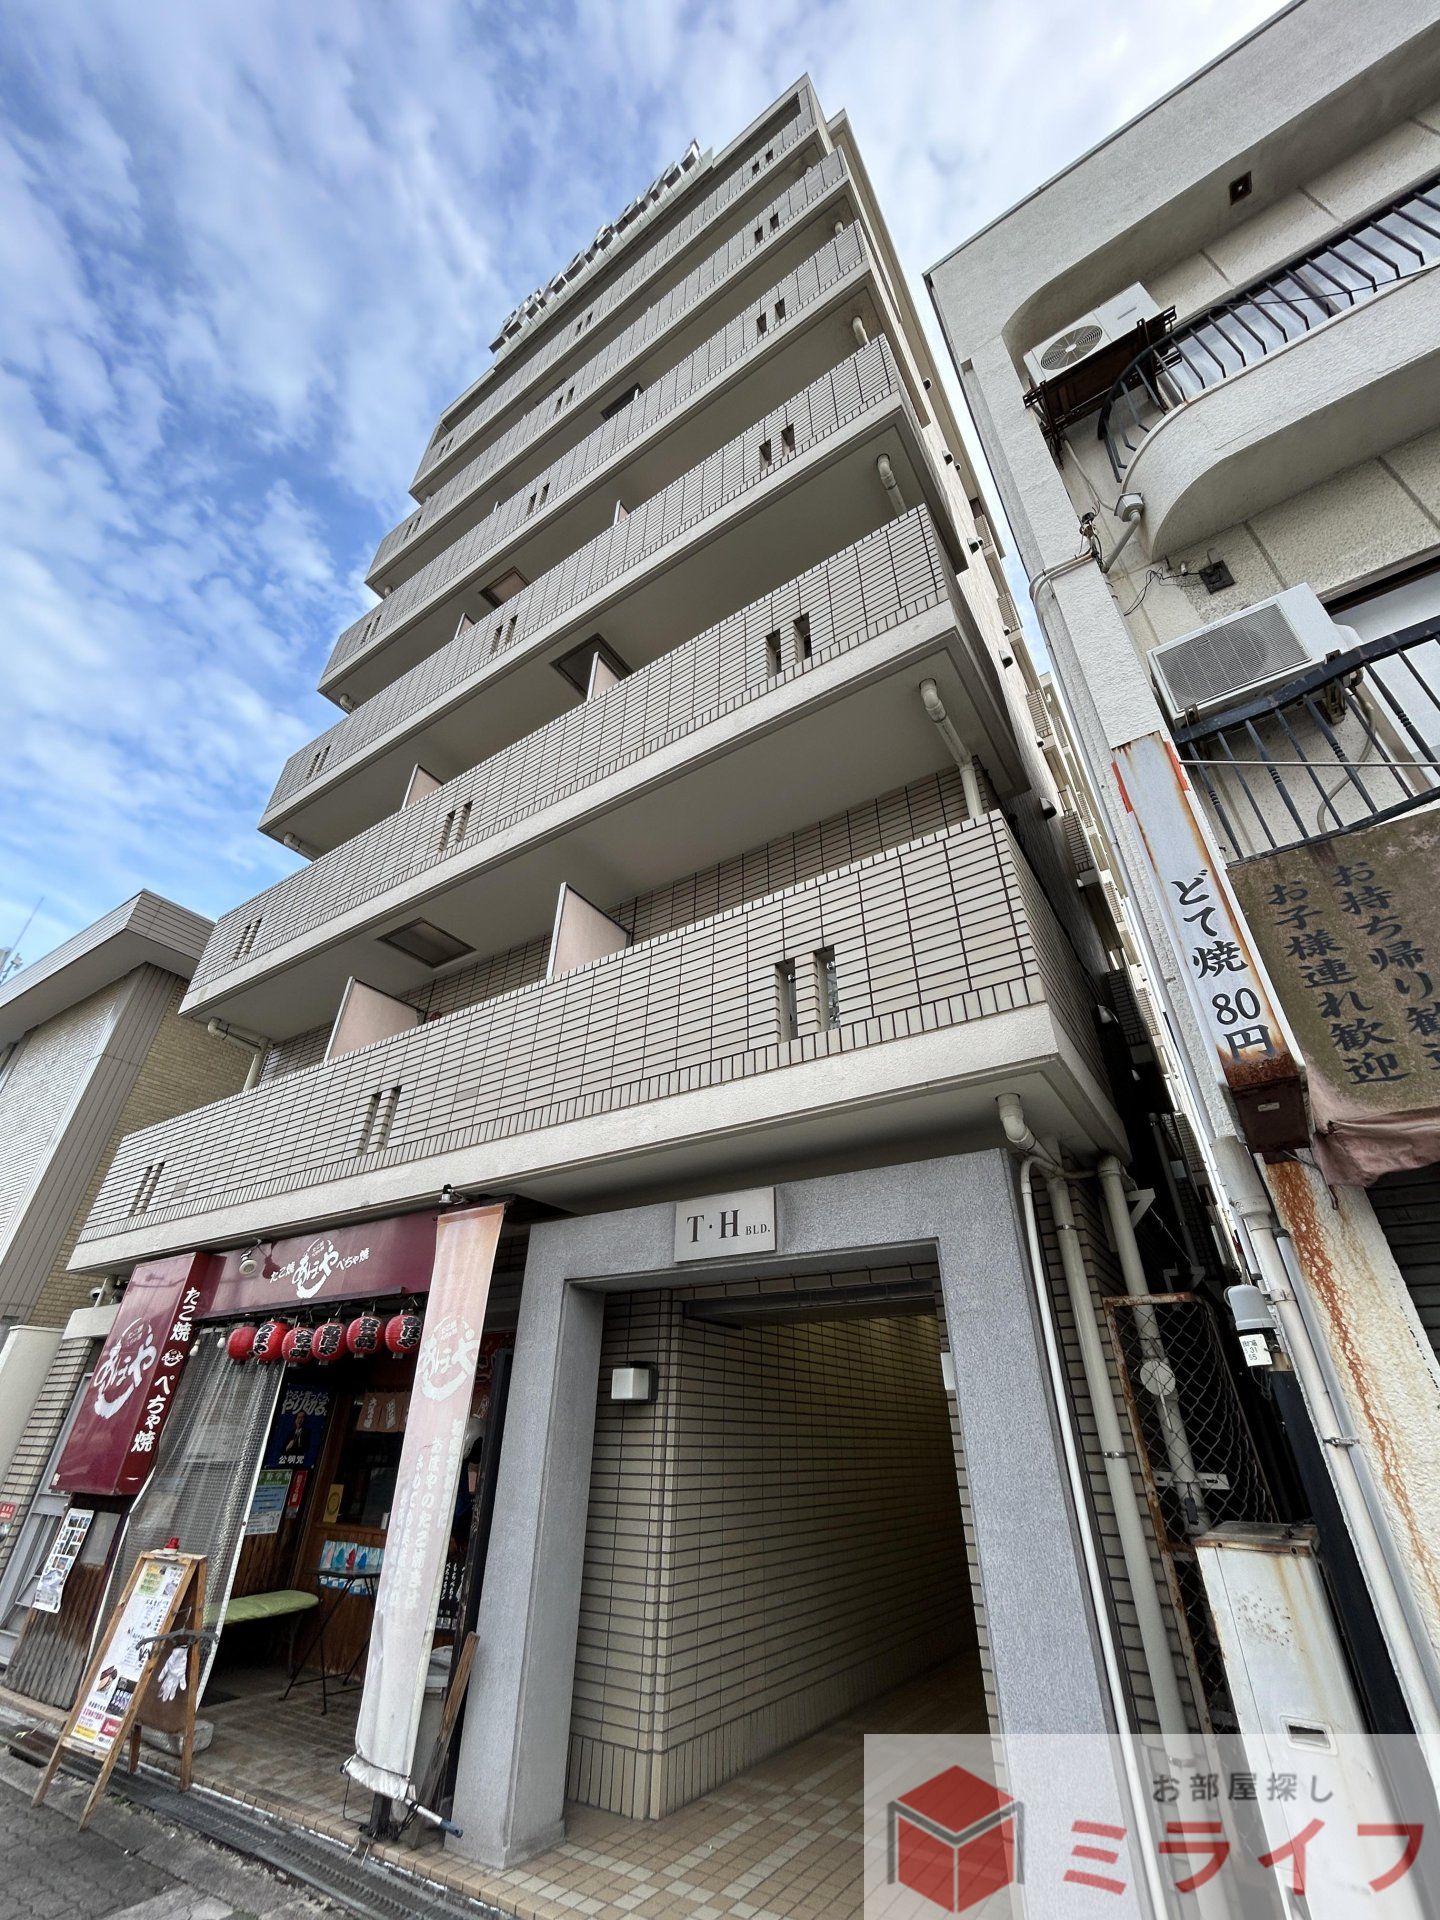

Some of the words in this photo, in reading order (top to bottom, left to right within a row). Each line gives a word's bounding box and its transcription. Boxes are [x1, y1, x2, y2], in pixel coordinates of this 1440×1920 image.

[1170, 869, 1249, 979] どて焼
[1210, 987, 1275, 1064] 80円
[1266, 880, 1411, 1085] お子様連れ歓迎
[745, 1223, 771, 1236] BLD.
[270, 1261, 296, 1284] たこ焼
[170, 1286, 201, 1342] たこ焼
[131, 1375, 176, 1453] ぺちゃ焼
[278, 1455, 305, 1465] 公明党
